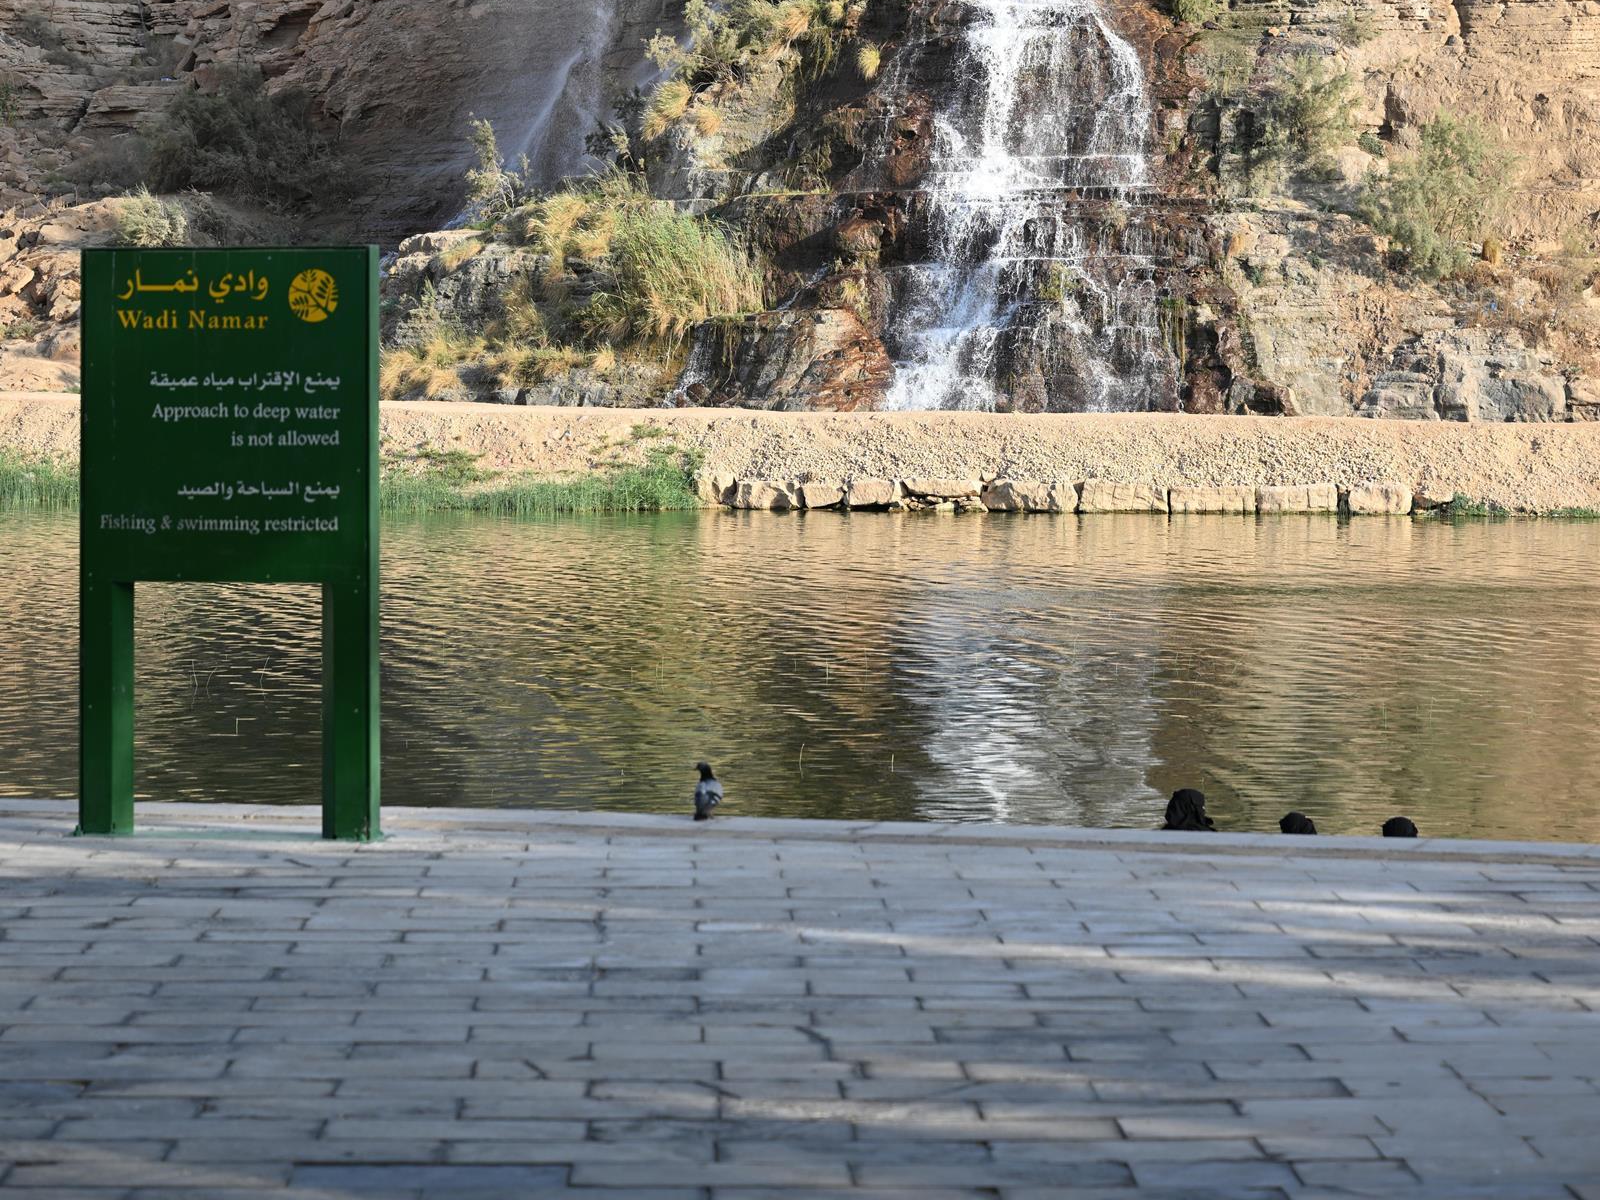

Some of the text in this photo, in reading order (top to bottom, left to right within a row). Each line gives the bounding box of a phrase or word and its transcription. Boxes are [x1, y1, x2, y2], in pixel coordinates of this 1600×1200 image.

[208, 269, 269, 303] وادي
[117, 309, 269, 329] Wadi Namar
[150, 371, 341, 393] يمنع الإقتراب مياه عميقة
[152, 403, 341, 422] Approach to deep water
[231, 430, 340, 447] is not allowed
[177, 481, 341, 502] يمنع السباحة والصيد
[99, 514, 339, 534] Fishing & swimming restricted
